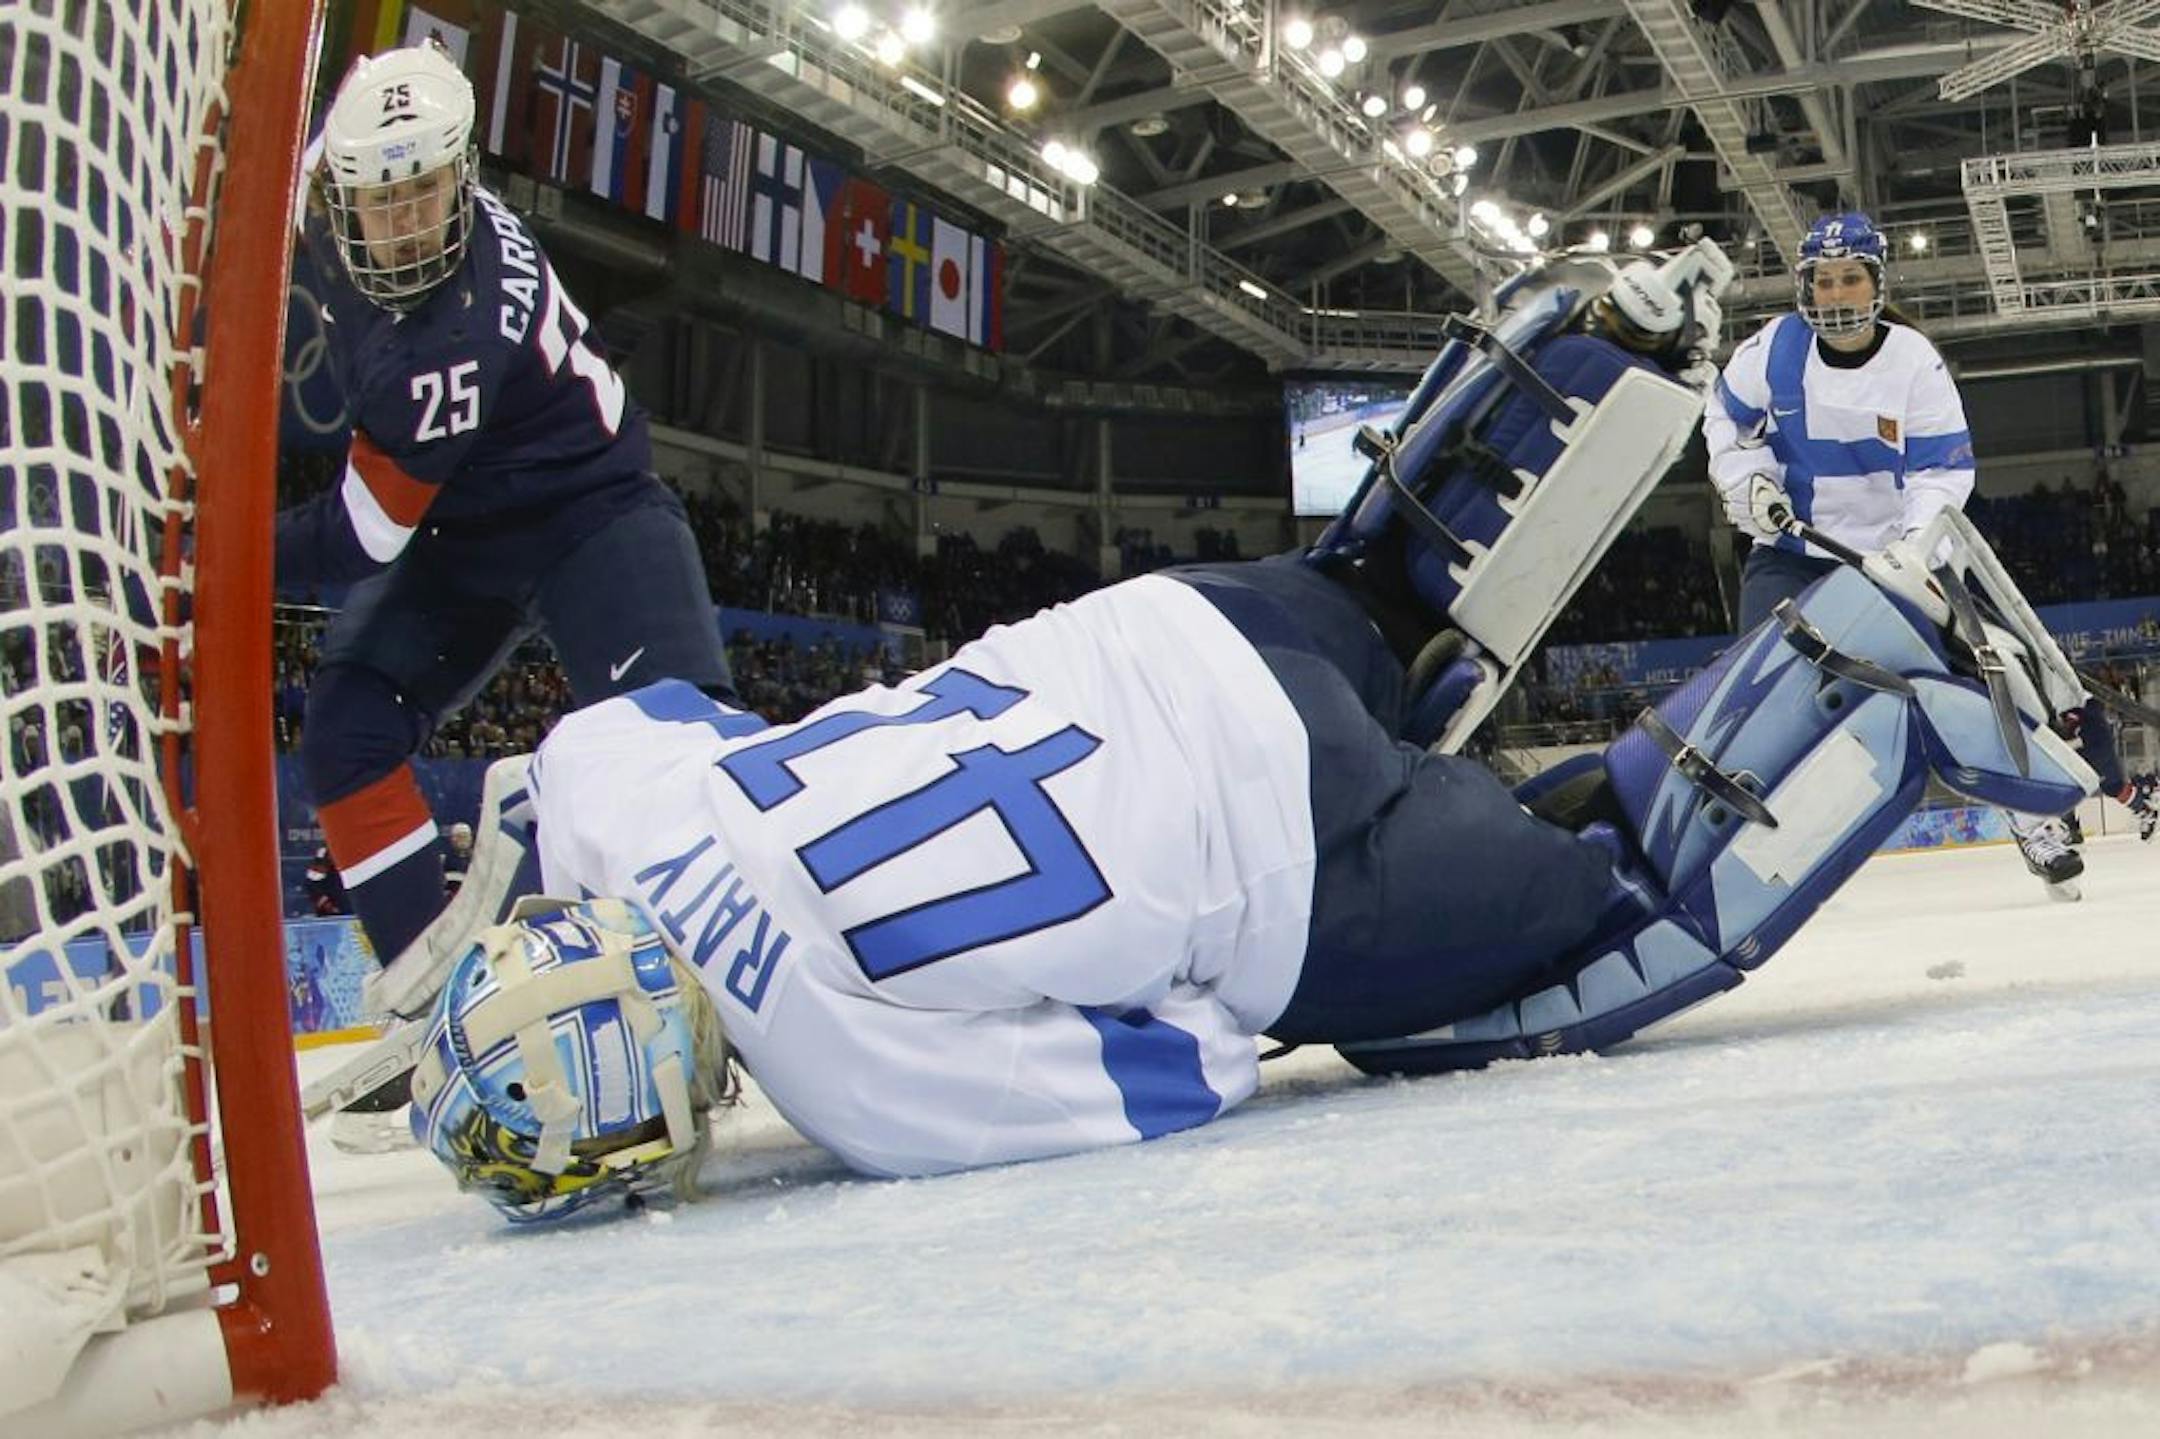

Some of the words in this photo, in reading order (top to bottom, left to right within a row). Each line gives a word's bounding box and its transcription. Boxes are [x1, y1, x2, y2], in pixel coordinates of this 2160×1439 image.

[382, 83, 411, 113] 25
[410, 360, 480, 443] 25
[634, 835, 792, 1015] RATY
